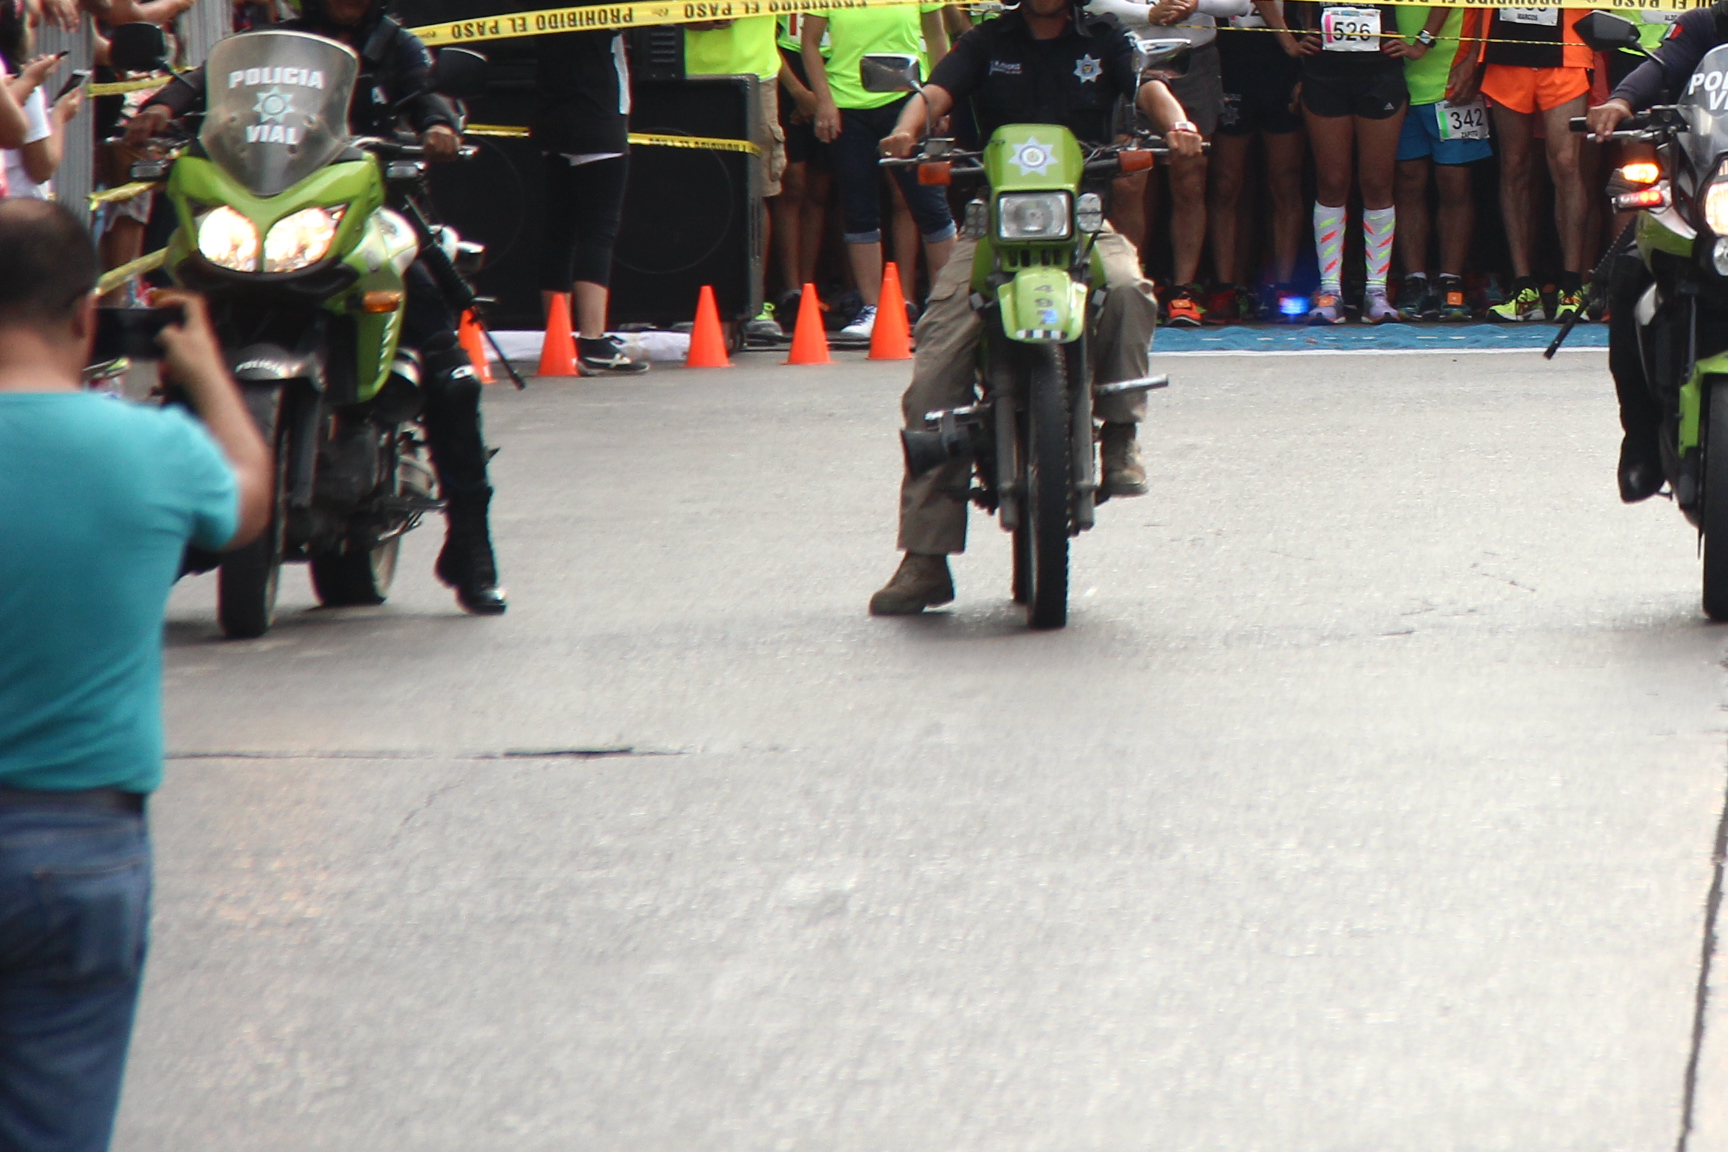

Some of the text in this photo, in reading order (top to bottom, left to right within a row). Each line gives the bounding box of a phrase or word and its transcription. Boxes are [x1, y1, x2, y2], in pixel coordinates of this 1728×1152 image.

[684, 2, 732, 18] PASO
[740, 0, 760, 15] EL
[451, 6, 634, 39] PROHIBIDO EL PASO
[1333, 22, 1371, 41] 526
[228, 67, 326, 90] POLICIA
[1451, 108, 1483, 129] 342
[246, 124, 300, 145] VIAL
